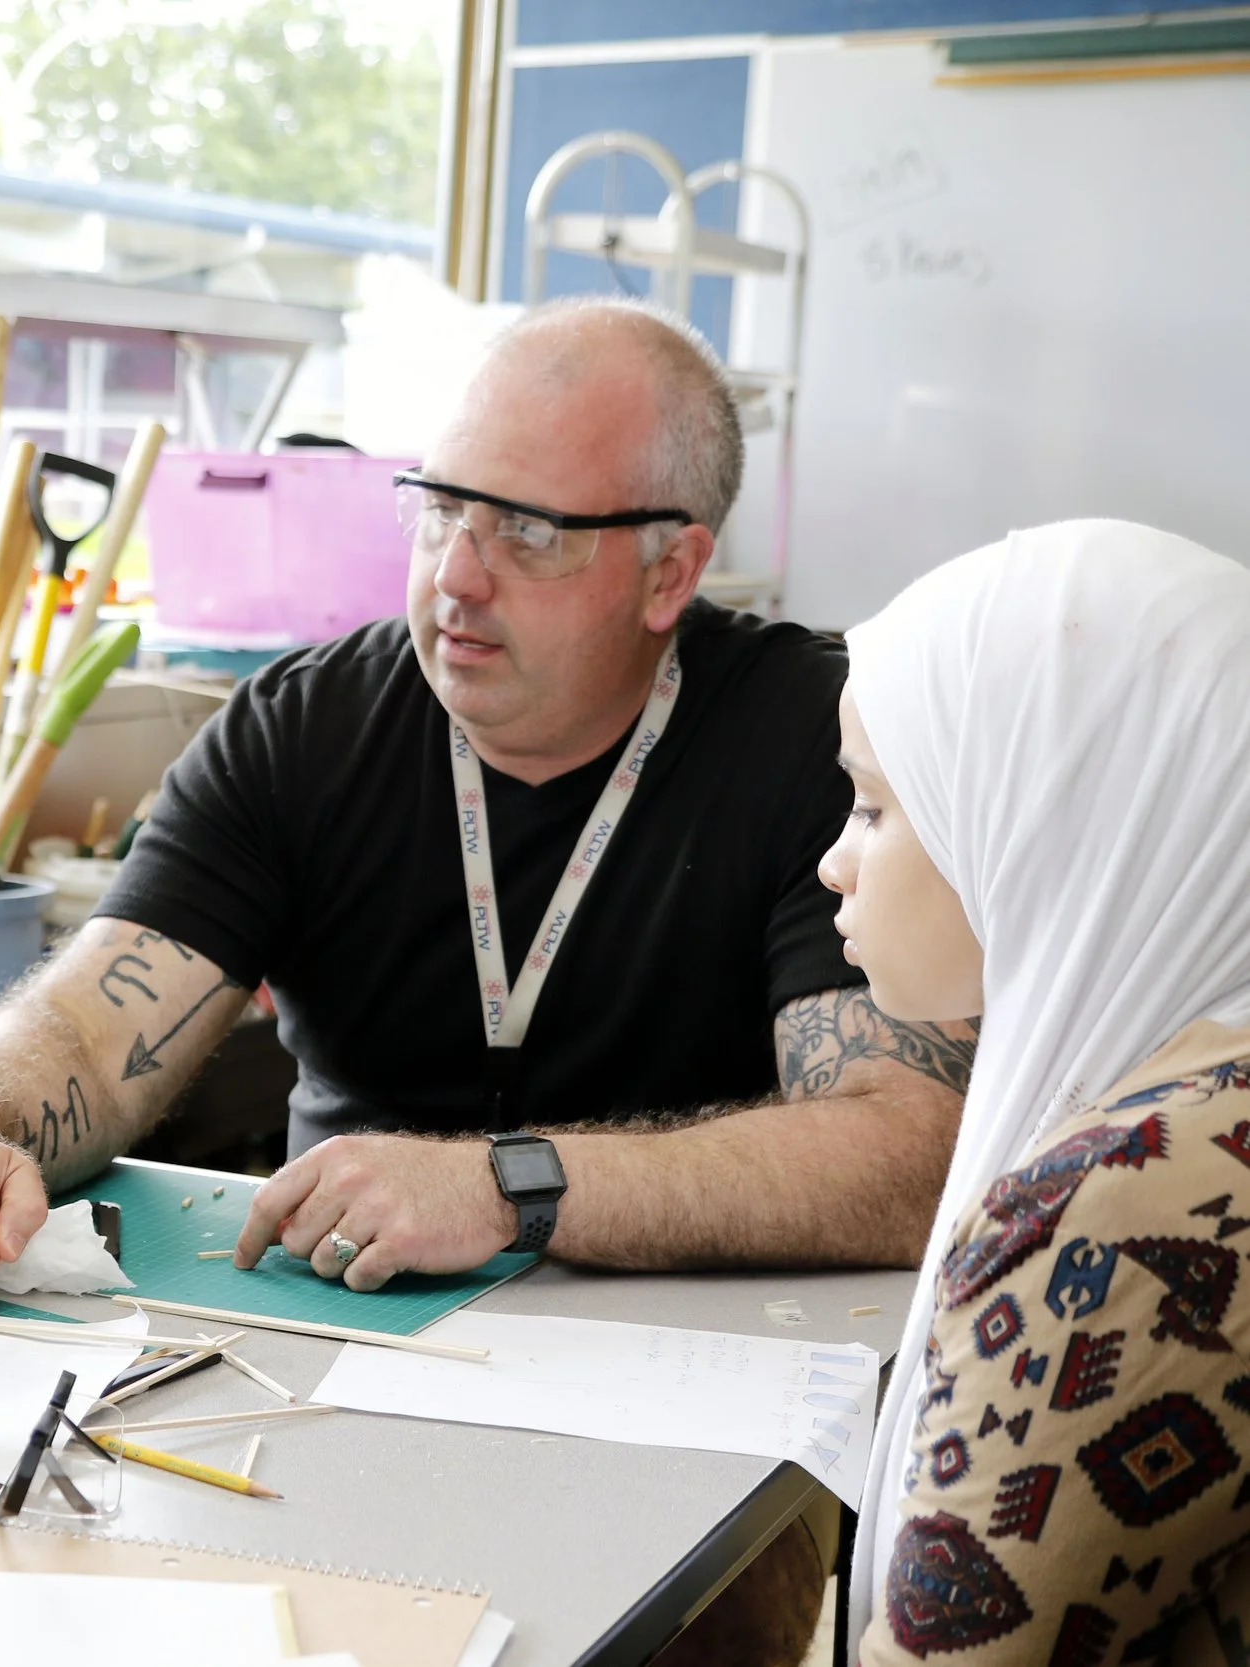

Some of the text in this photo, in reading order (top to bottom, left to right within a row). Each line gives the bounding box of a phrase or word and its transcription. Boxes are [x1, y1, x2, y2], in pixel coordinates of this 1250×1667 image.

[454, 726, 468, 759] LTW
[628, 729, 656, 773] PLTW
[462, 810, 479, 854] PLTW
[583, 820, 611, 863] PLTW
[474, 906, 491, 950] PLTW
[542, 910, 567, 953] PLTW
[487, 1000, 502, 1034] PLT
